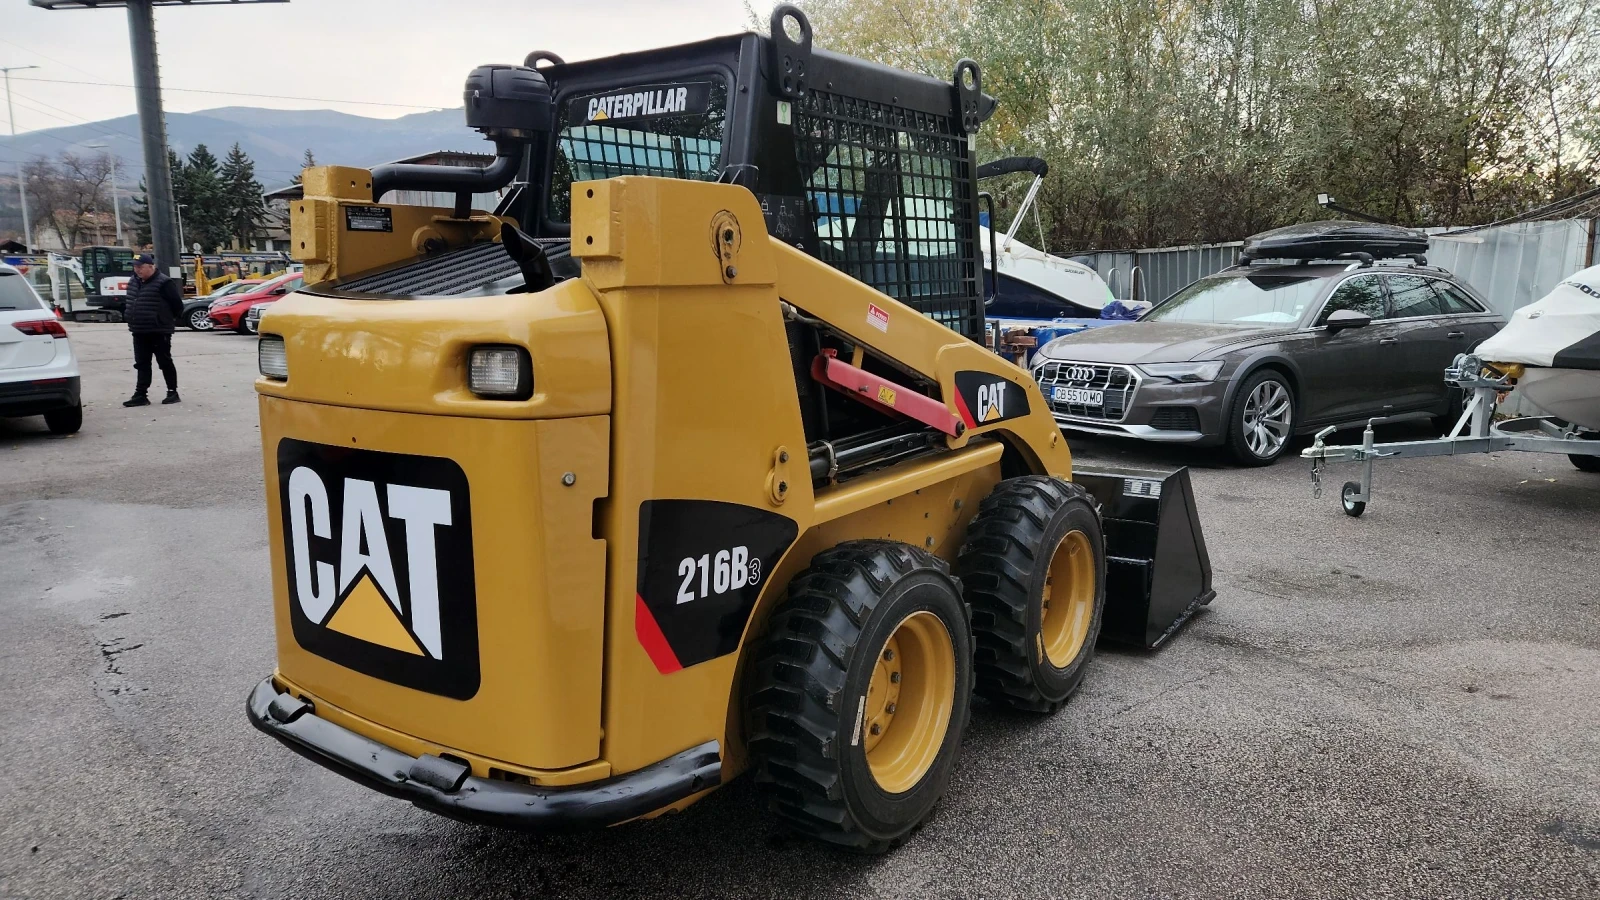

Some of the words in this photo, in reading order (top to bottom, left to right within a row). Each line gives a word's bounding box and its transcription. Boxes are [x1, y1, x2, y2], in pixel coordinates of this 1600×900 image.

[588, 87, 687, 121] CATERPILLAR
[978, 381, 1006, 423] CAT
[1067, 389, 1088, 402] 5510
[1090, 392, 1101, 404] MO
[288, 466, 452, 661] CAT
